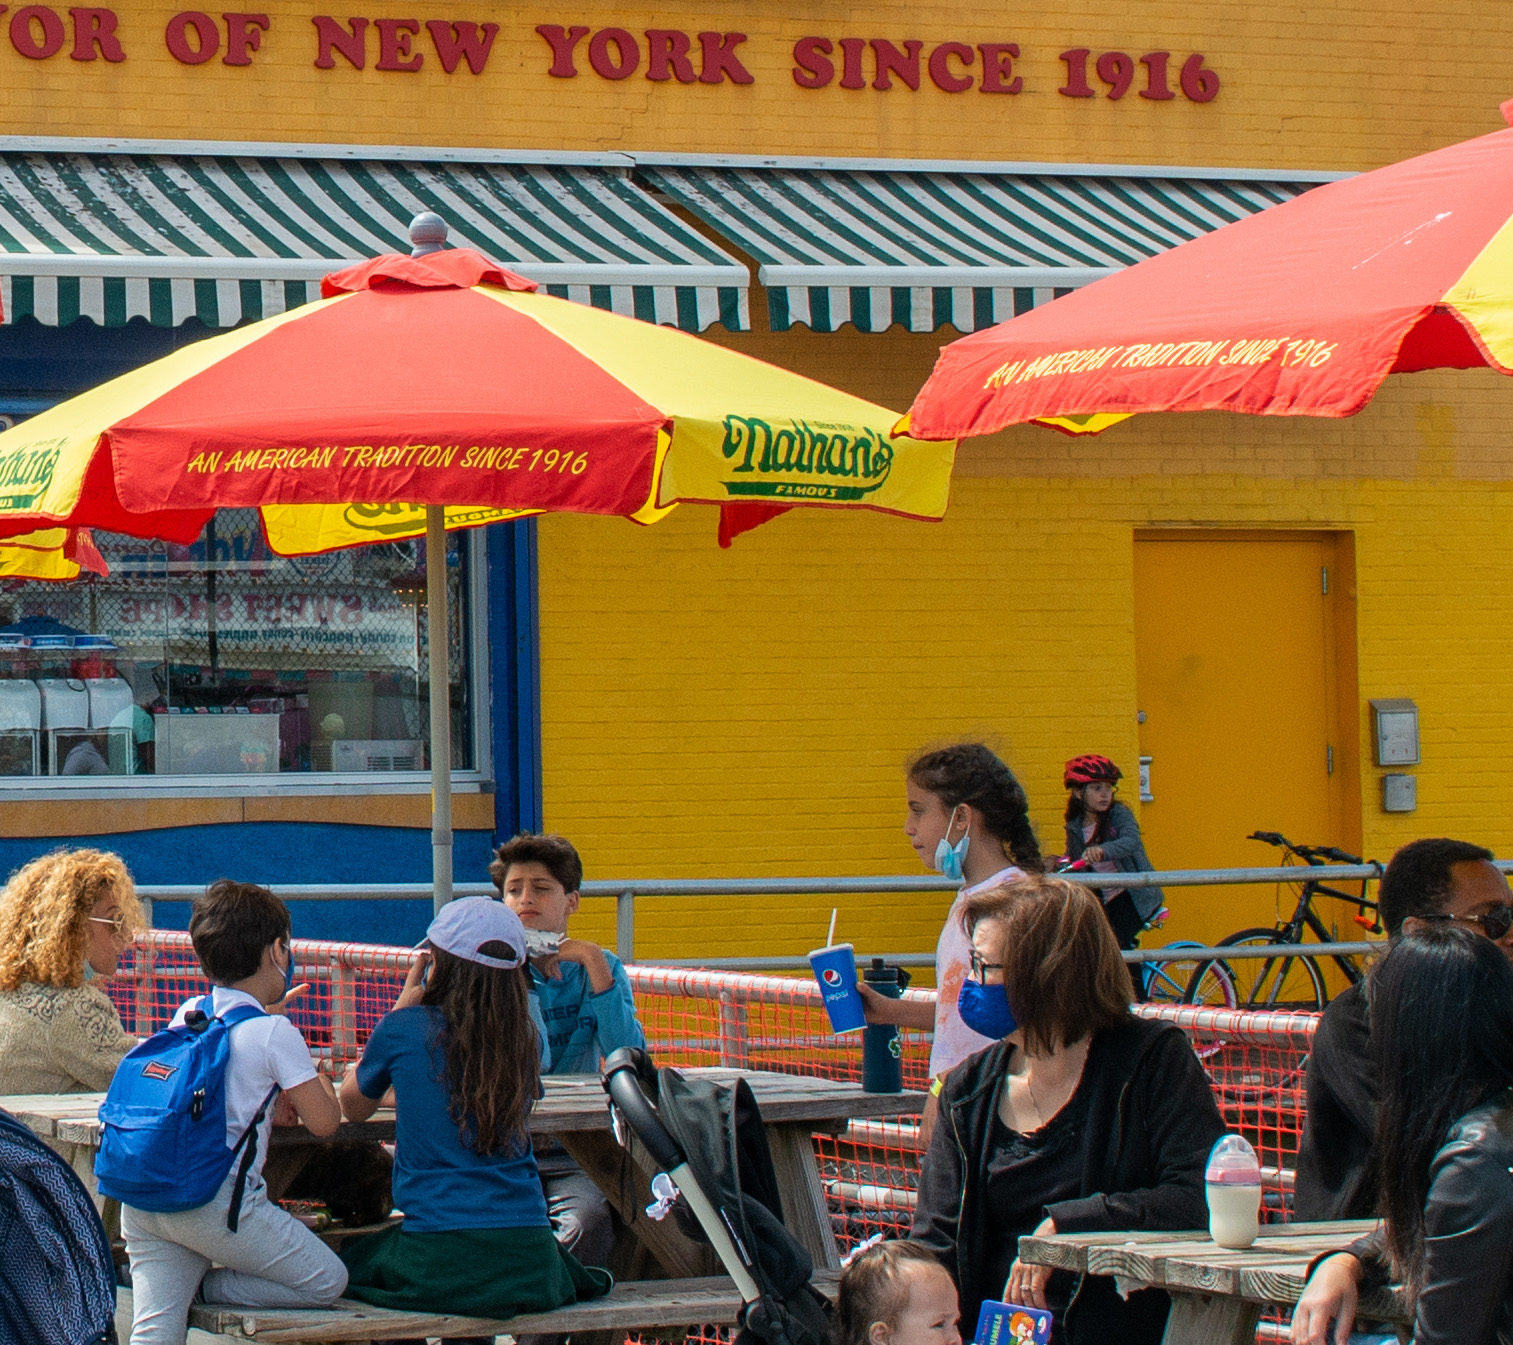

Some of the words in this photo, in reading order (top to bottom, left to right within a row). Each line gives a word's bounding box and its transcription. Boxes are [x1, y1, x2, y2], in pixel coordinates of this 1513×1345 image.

[165, 9, 270, 69] OF
[312, 15, 500, 77] NEW
[536, 26, 754, 87] YORK
[792, 36, 1024, 97] SINCE
[1058, 47, 1222, 105] 1916
[983, 360, 1025, 389] AN
[1016, 346, 1123, 384] AMERICAN
[1114, 340, 1230, 368] TRADITION
[1220, 337, 1290, 365] SINCE
[1281, 340, 1338, 368] 1916
[188, 451, 223, 473] AN
[224, 446, 338, 472] AMERICAN
[343, 444, 459, 470] TRADITION
[459, 446, 530, 470] SINCE
[528, 448, 589, 475] 1916
[722, 414, 894, 478] Nathan's
[775, 484, 838, 498] FAMOUS
[827, 988, 849, 1003] pepsi
